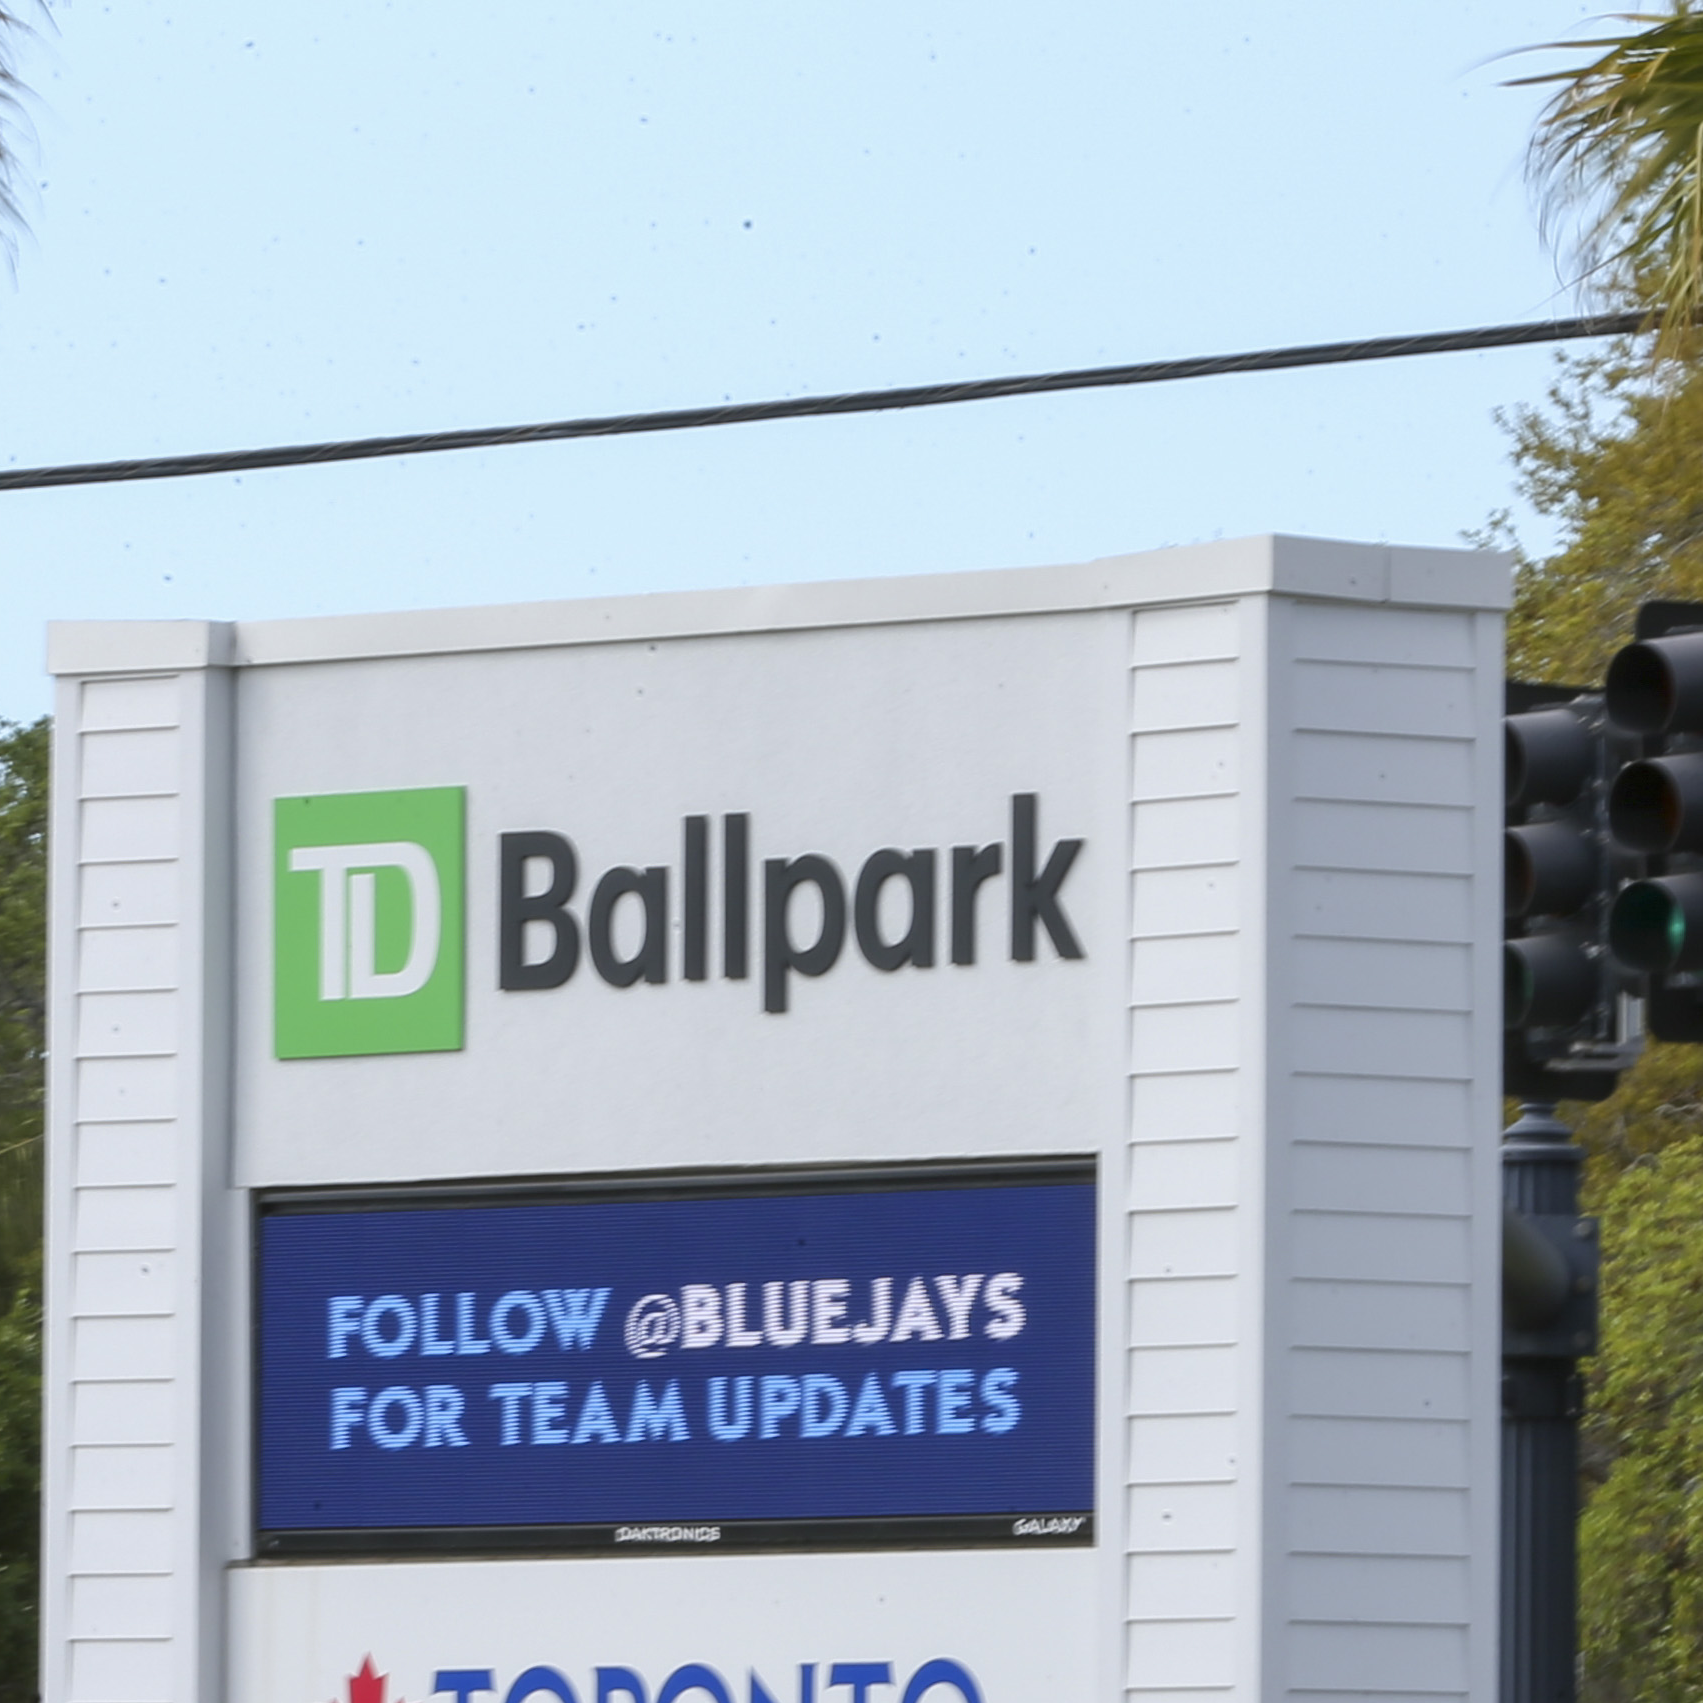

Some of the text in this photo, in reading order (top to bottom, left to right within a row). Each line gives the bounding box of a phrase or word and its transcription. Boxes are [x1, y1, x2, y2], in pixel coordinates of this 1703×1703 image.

[288, 792, 1087, 1015] TD Ballpark
[326, 1272, 1027, 1359] FOLLOW @BLUEJAYS
[329, 1366, 1023, 1450] FOR TEAM UPDATES
[614, 1525, 721, 1543] DAKTRONICS
[1012, 1516, 1086, 1536] GALAXY
